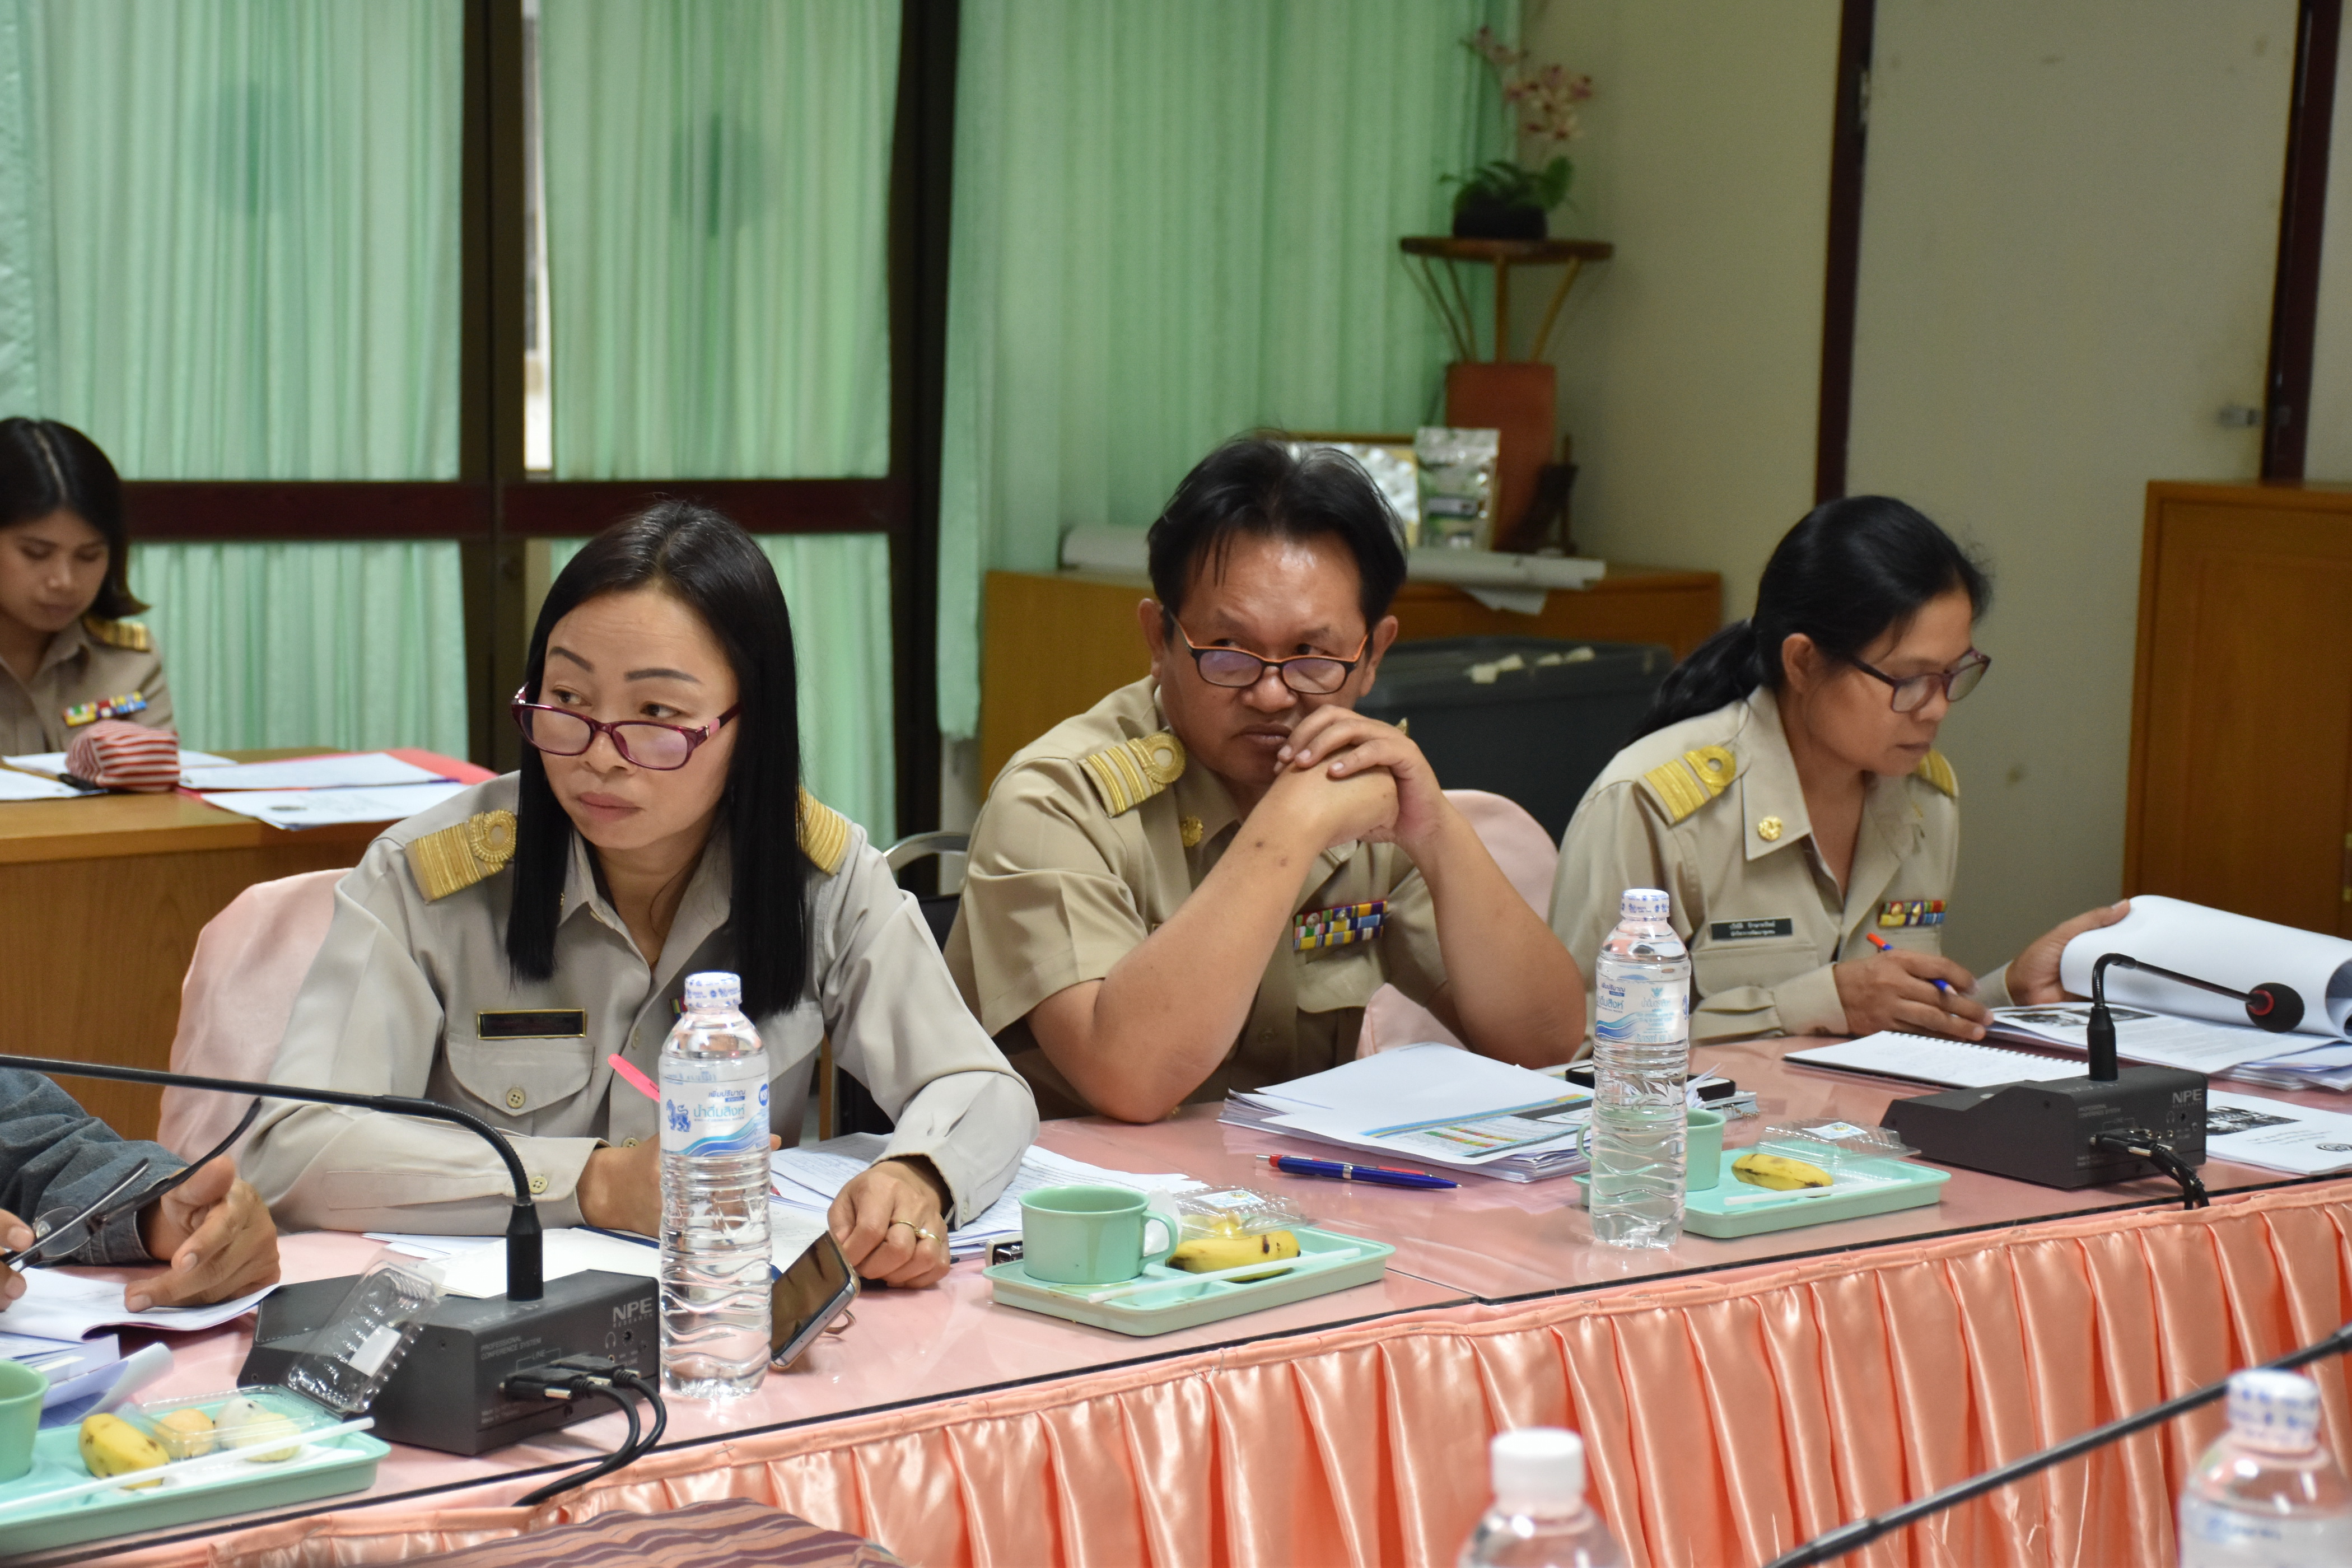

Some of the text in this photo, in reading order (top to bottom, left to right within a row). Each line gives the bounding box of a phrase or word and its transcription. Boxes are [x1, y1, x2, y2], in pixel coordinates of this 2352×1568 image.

[2172, 1088, 2202, 1103] NPE
[694, 1104, 745, 1118] น้ำดื่มสิงห์
[613, 1297, 652, 1322] NPE
[613, 1313, 653, 1327] RESEARCH
[481, 1336, 522, 1351] PROFESSIONAL
[481, 1337, 542, 1360] CONFERENCE SYSTEM
